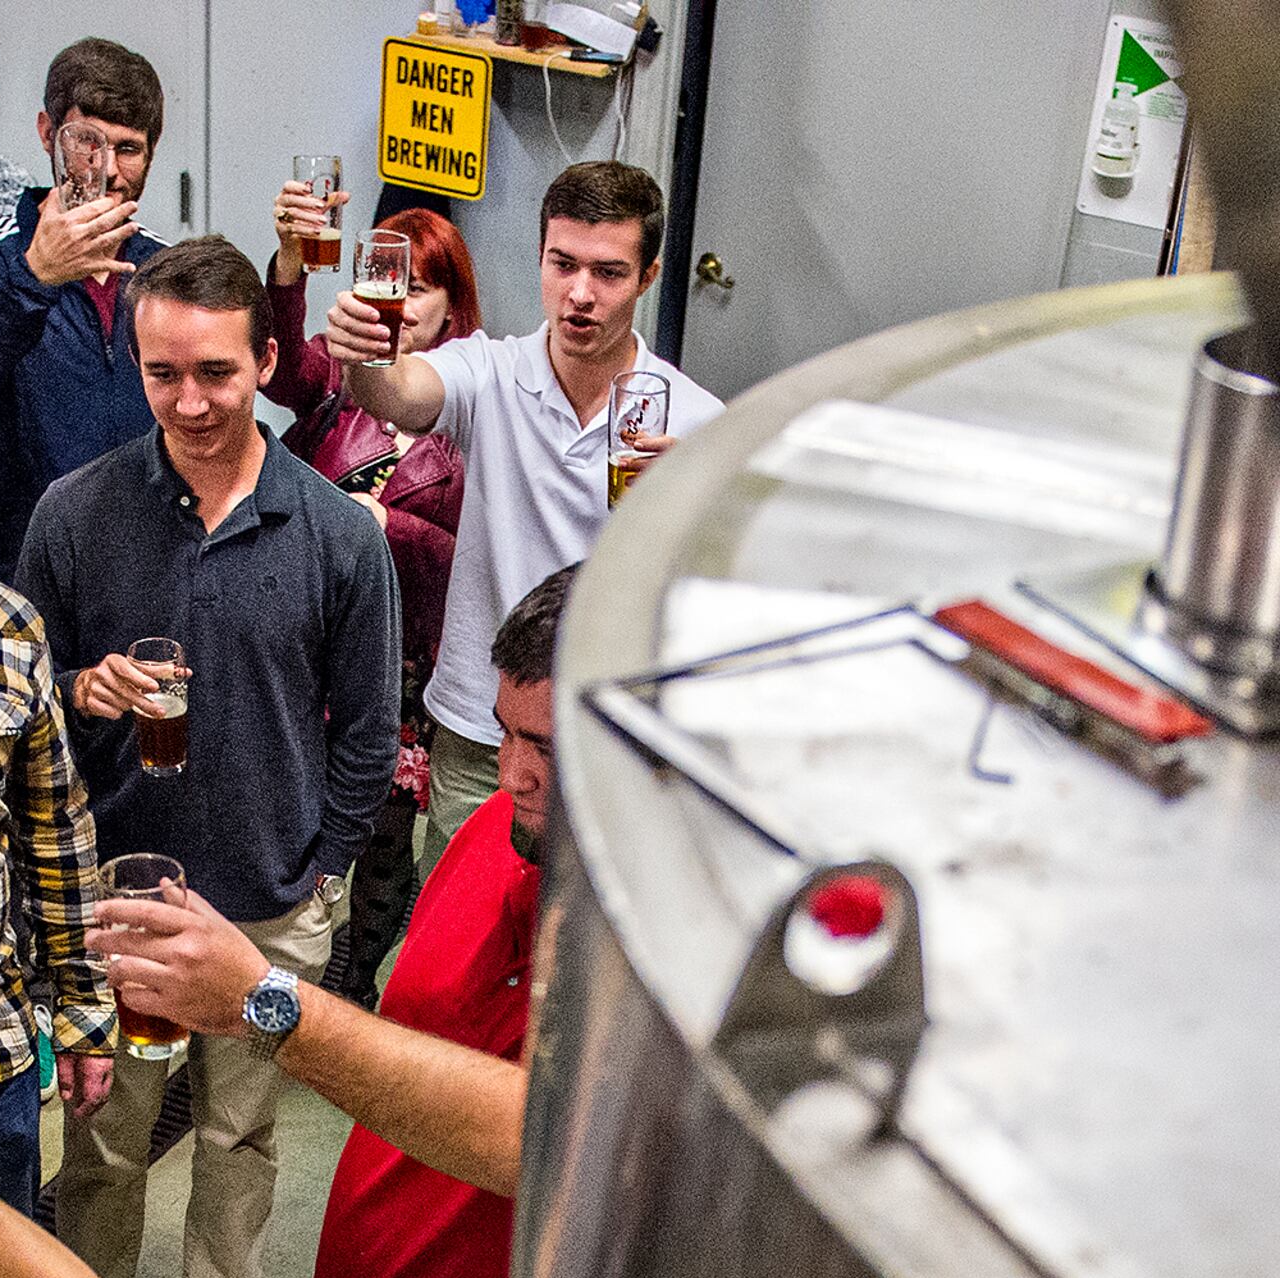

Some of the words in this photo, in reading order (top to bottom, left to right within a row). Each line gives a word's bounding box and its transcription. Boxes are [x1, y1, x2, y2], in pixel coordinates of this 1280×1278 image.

[397, 56, 474, 98] DANGER
[411, 100, 454, 135] MEN
[387, 135, 477, 179] BREWING
